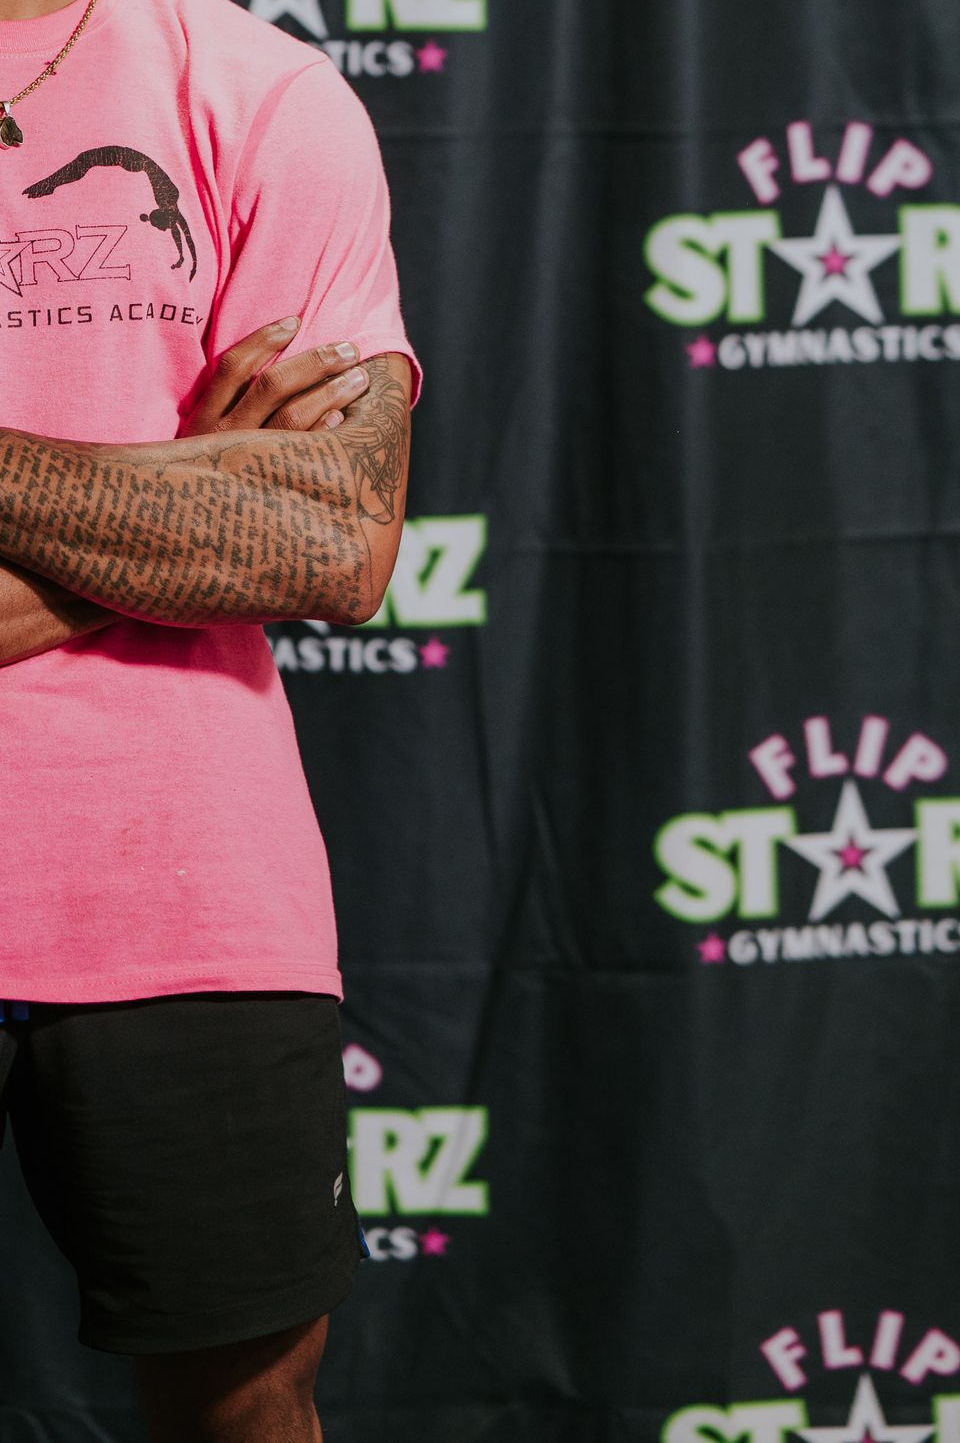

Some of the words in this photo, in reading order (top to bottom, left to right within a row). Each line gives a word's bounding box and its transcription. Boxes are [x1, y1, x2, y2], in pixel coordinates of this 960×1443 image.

[737, 120, 933, 205] FLIP
[108, 302, 204, 325] ACADE
[748, 715, 949, 801] FLIP
[727, 917, 960, 967] GYMNASTIC
[759, 1308, 960, 1392] FLIP
